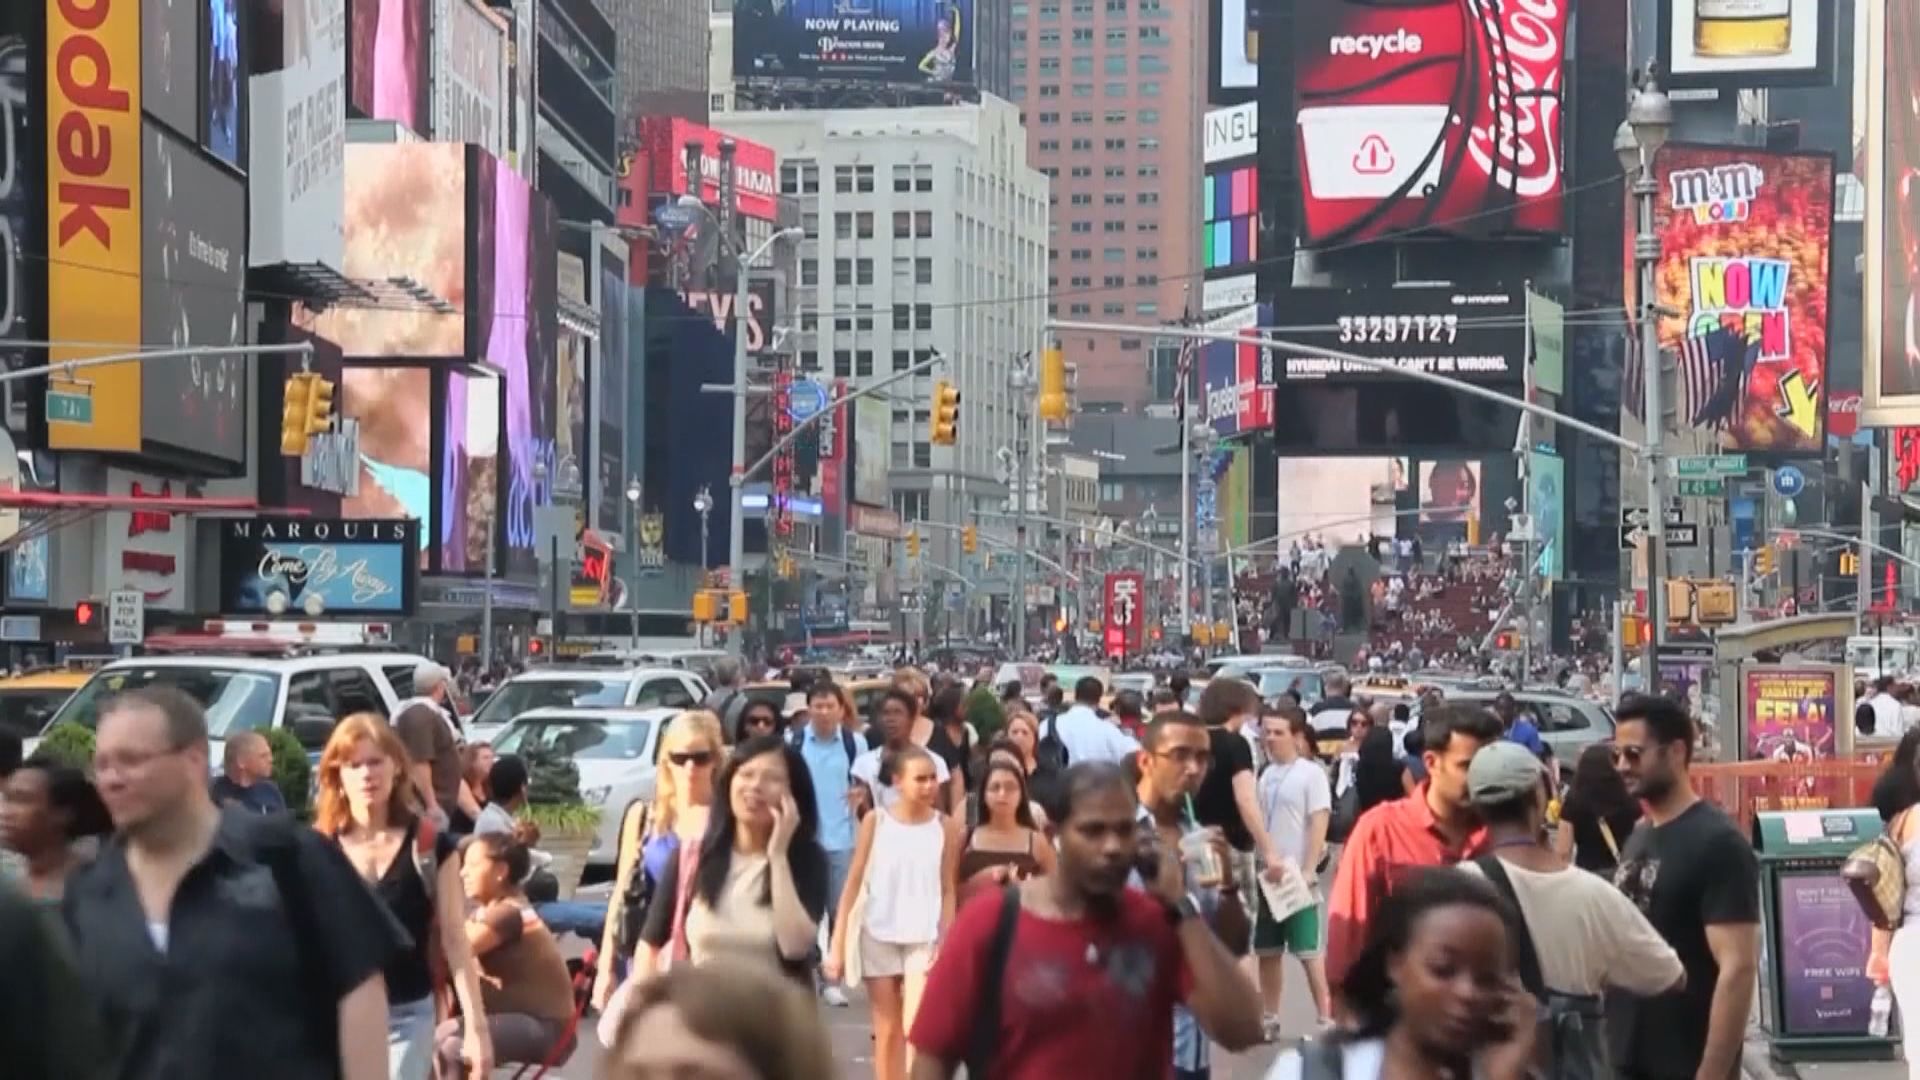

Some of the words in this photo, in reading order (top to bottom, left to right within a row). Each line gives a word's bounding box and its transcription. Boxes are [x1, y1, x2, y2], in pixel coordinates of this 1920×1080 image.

[804, 18, 840, 31] NOW
[843, 18, 900, 32] PLAYING
[1330, 28, 1422, 59] recycle
[1699, 261, 1785, 309] NOW
[1467, 295, 1510, 304] HYUNDAI
[1286, 358, 1340, 373] HYUNDAI
[1398, 356, 1435, 373] CAN'T
[1438, 356, 1454, 371] BE
[1457, 355, 1509, 371] WRONG.
[234, 522, 405, 539] MARQUIS
[258, 543, 307, 582] Come
[290, 544, 338, 585] Fly
[338, 557, 393, 603] Away
[116, 595, 137, 603] WAIT
[118, 606, 135, 614] FOR
[1804, 967, 1832, 978] FREE
